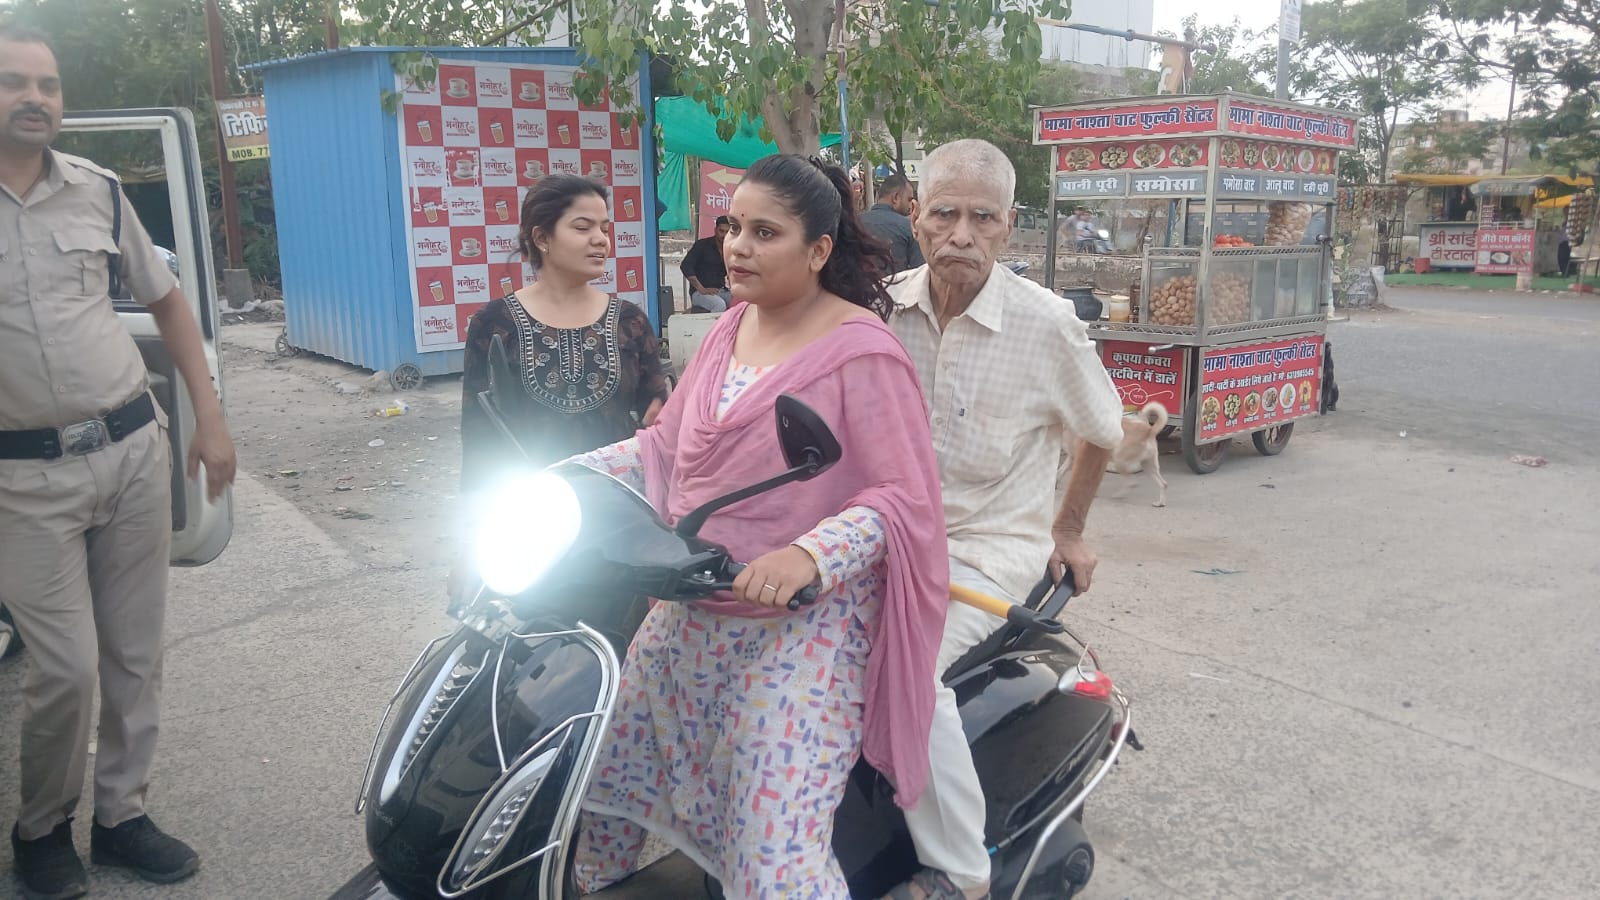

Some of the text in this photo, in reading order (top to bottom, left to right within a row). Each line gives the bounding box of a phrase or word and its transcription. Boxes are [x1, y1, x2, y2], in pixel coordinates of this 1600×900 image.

[222, 111, 267, 137] टिफि
[1044, 105, 1215, 131] मामा नाश्ता चाट फुल्की सेंटर
[1229, 106, 1349, 139] मामा नाश्ता चाट फुल्की सेंटर
[232, 148, 256, 160] MOB.
[1062, 177, 1119, 193] पानी पूरी
[1135, 175, 1200, 192] समोसा
[1243, 178, 1255, 192] चाट
[1265, 178, 1295, 193] आलू चाट
[1304, 182, 1316, 193] दही
[705, 188, 733, 211] मनो
[1429, 230, 1446, 246] श्री
[1431, 247, 1443, 260] टी
[1112, 352, 1171, 368] कृपया कचरा
[1203, 355, 1227, 372] मामा
[1229, 352, 1255, 368] नाश्ता
[1256, 350, 1272, 365] चाट
[1274, 342, 1298, 368] फुल्की
[1144, 369, 1154, 383] में
[1155, 372, 1178, 385] डालें
